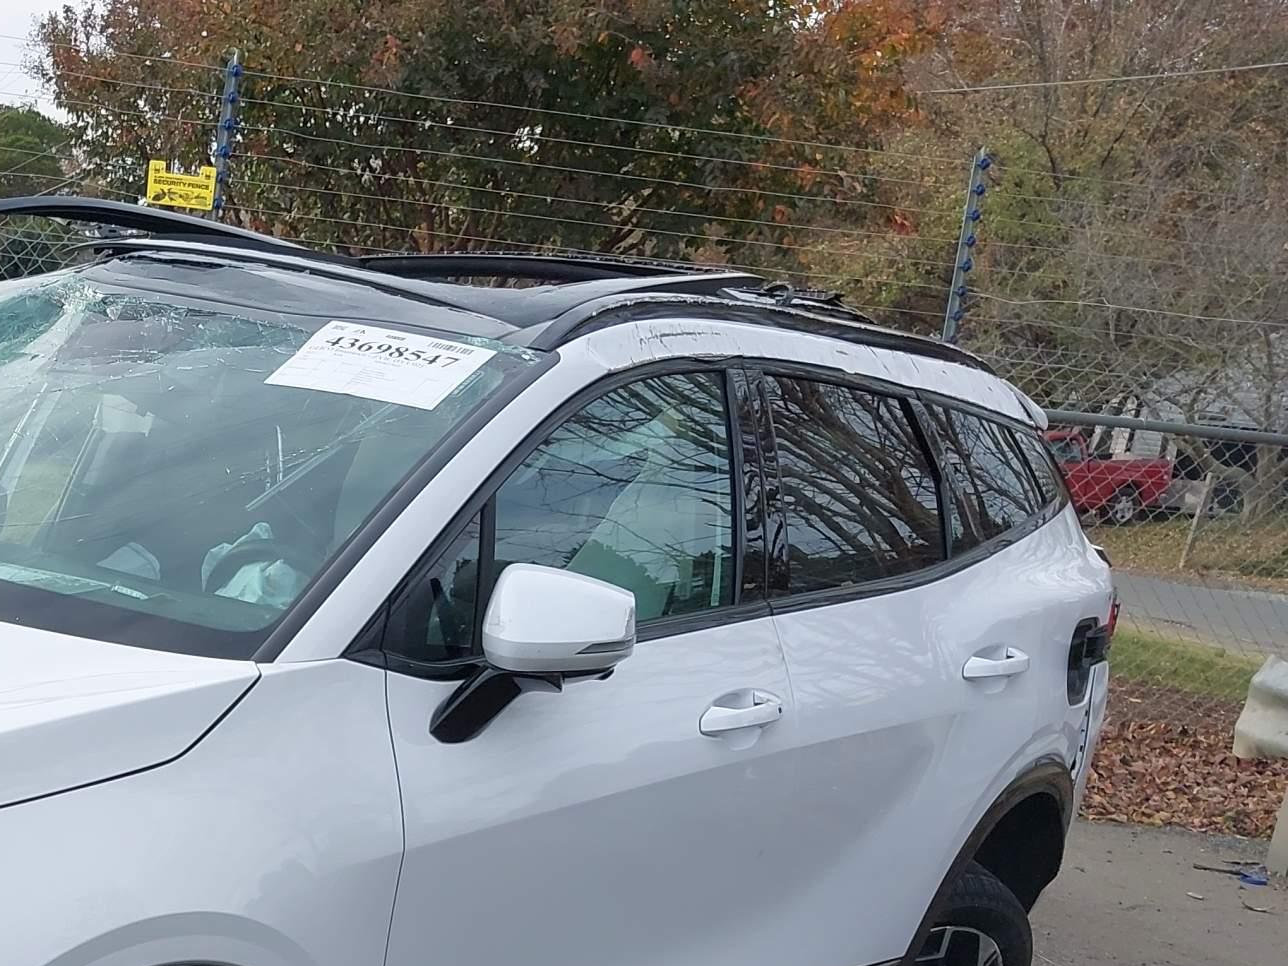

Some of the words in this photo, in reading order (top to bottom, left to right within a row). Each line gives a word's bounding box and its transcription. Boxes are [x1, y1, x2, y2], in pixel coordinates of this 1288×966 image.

[153, 178, 187, 188] SECURITY
[187, 182, 210, 190] FENCE
[325, 336, 462, 368] 43698547
